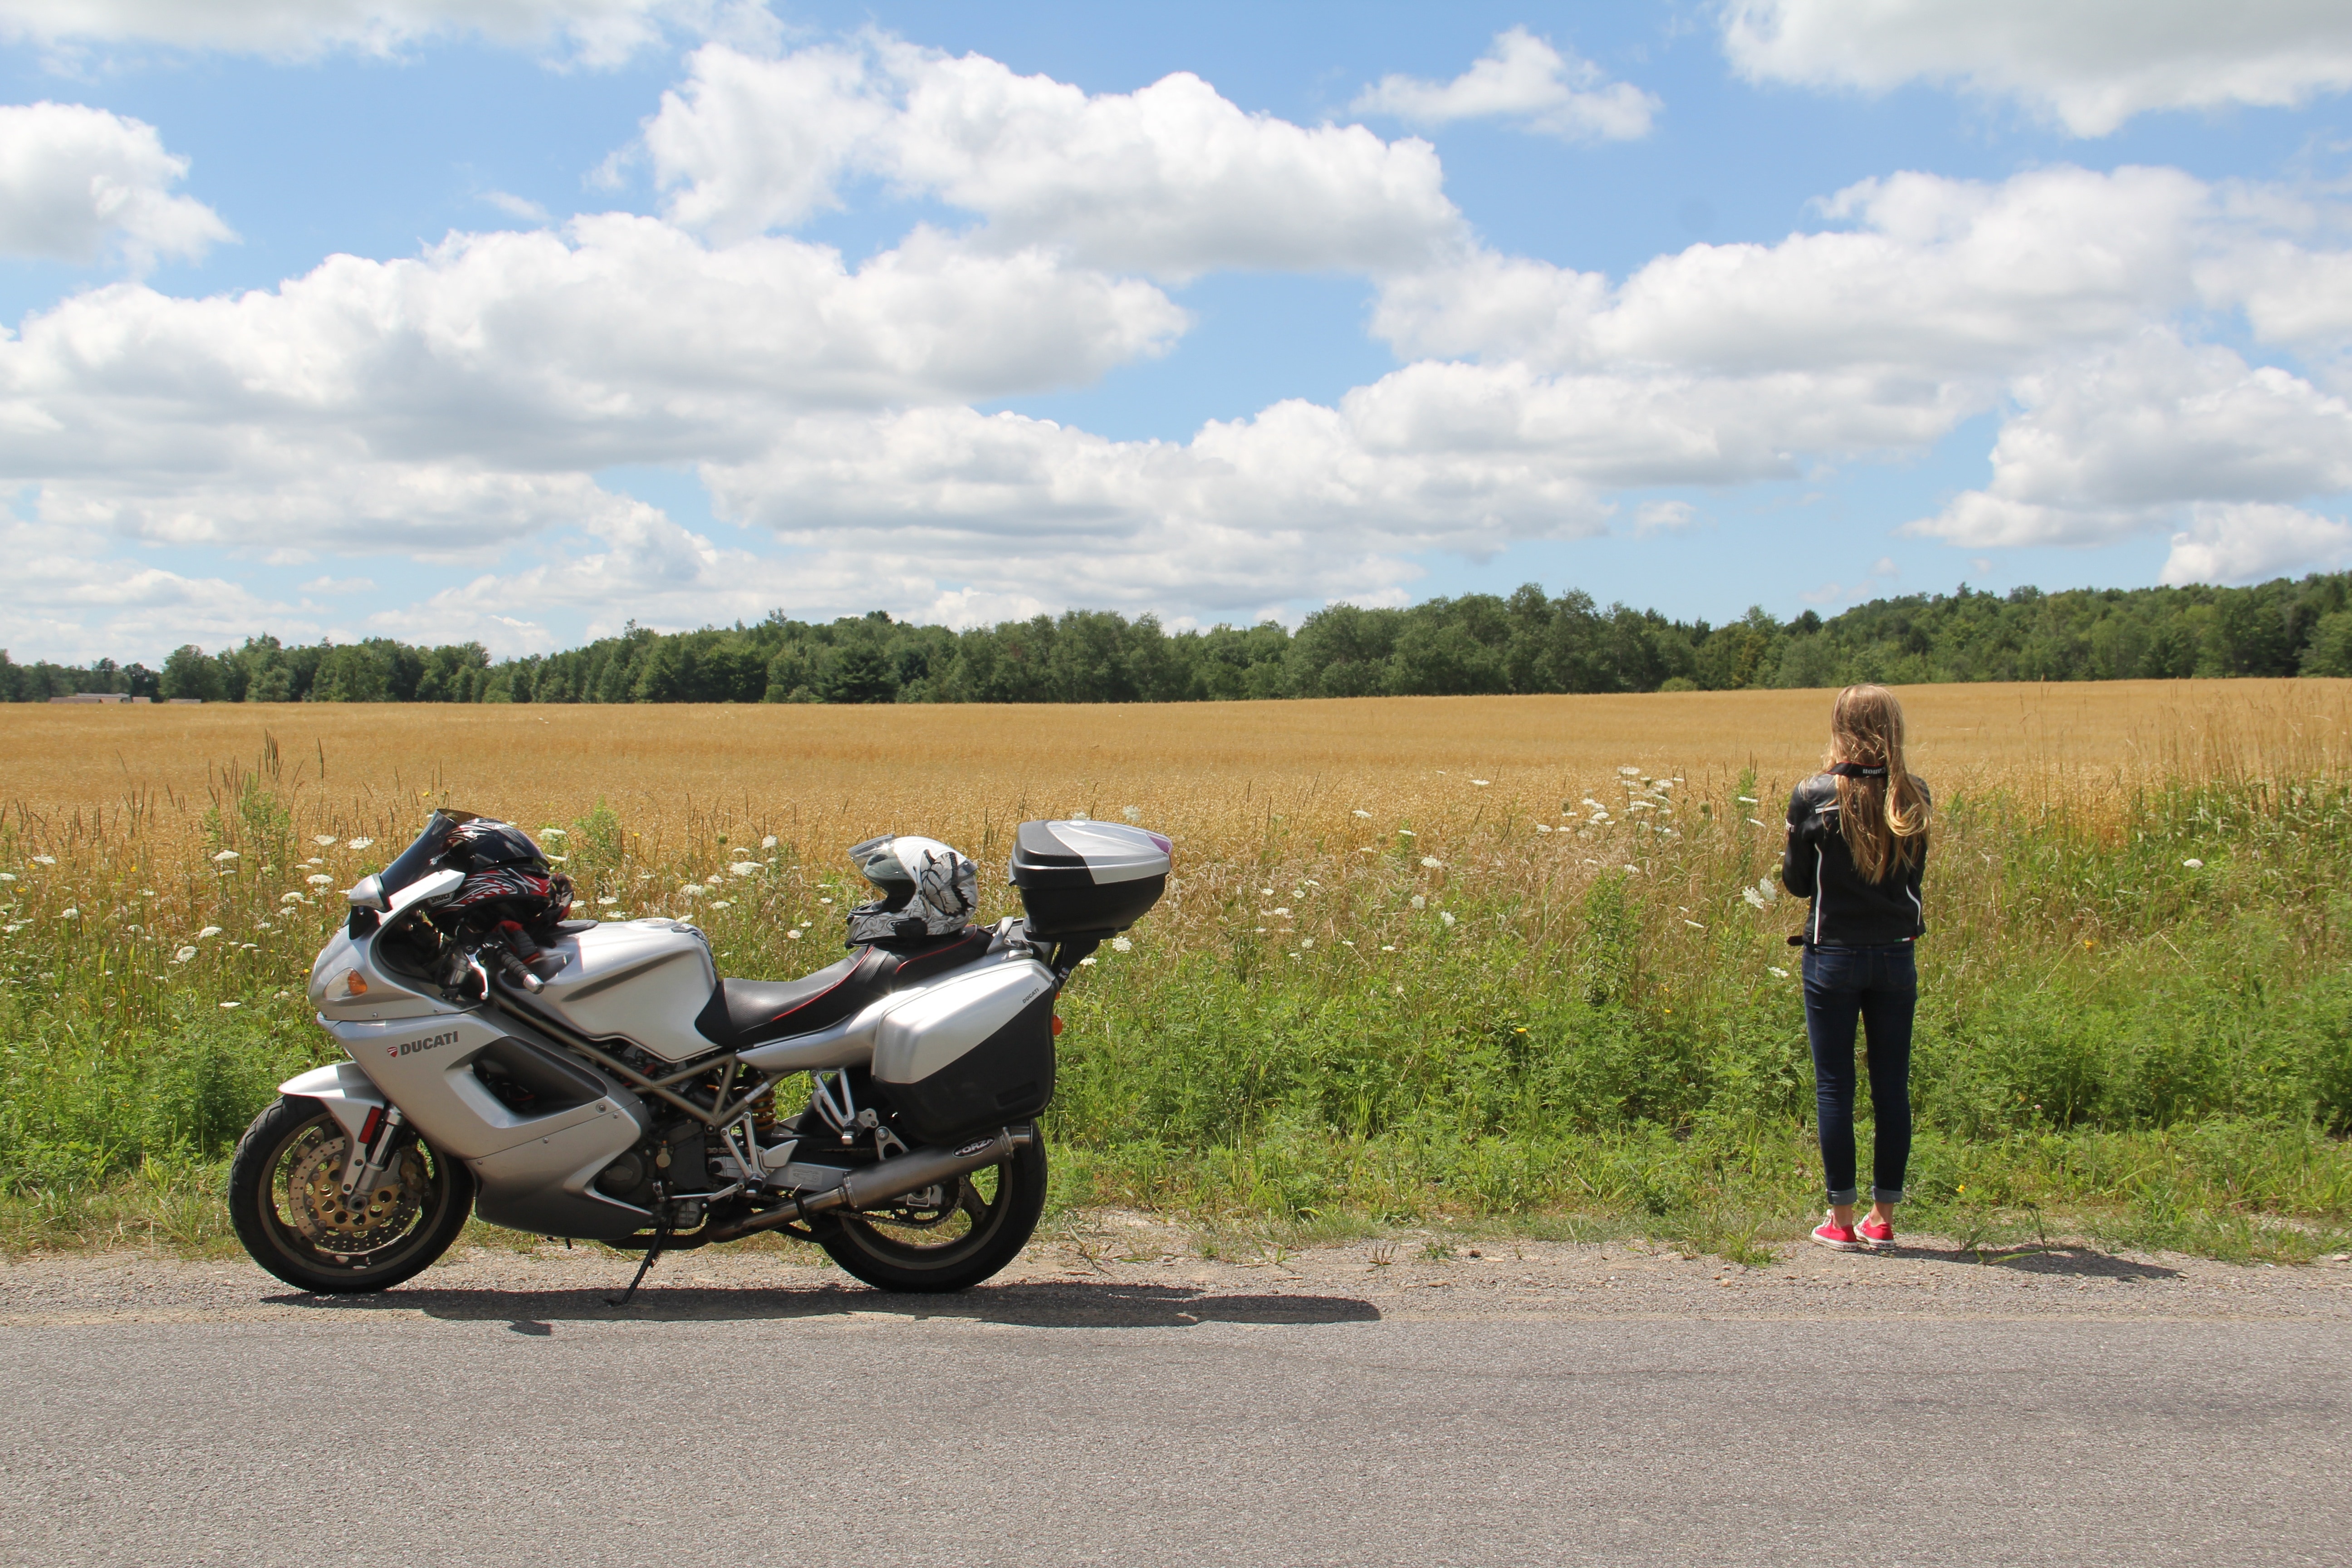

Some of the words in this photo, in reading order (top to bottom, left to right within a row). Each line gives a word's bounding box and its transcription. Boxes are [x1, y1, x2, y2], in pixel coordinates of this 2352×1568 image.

[1022, 987, 1039, 1004] DUCATI
[400, 1030, 459, 1055] DUCATI
[955, 1138, 994, 1156] FORZA
